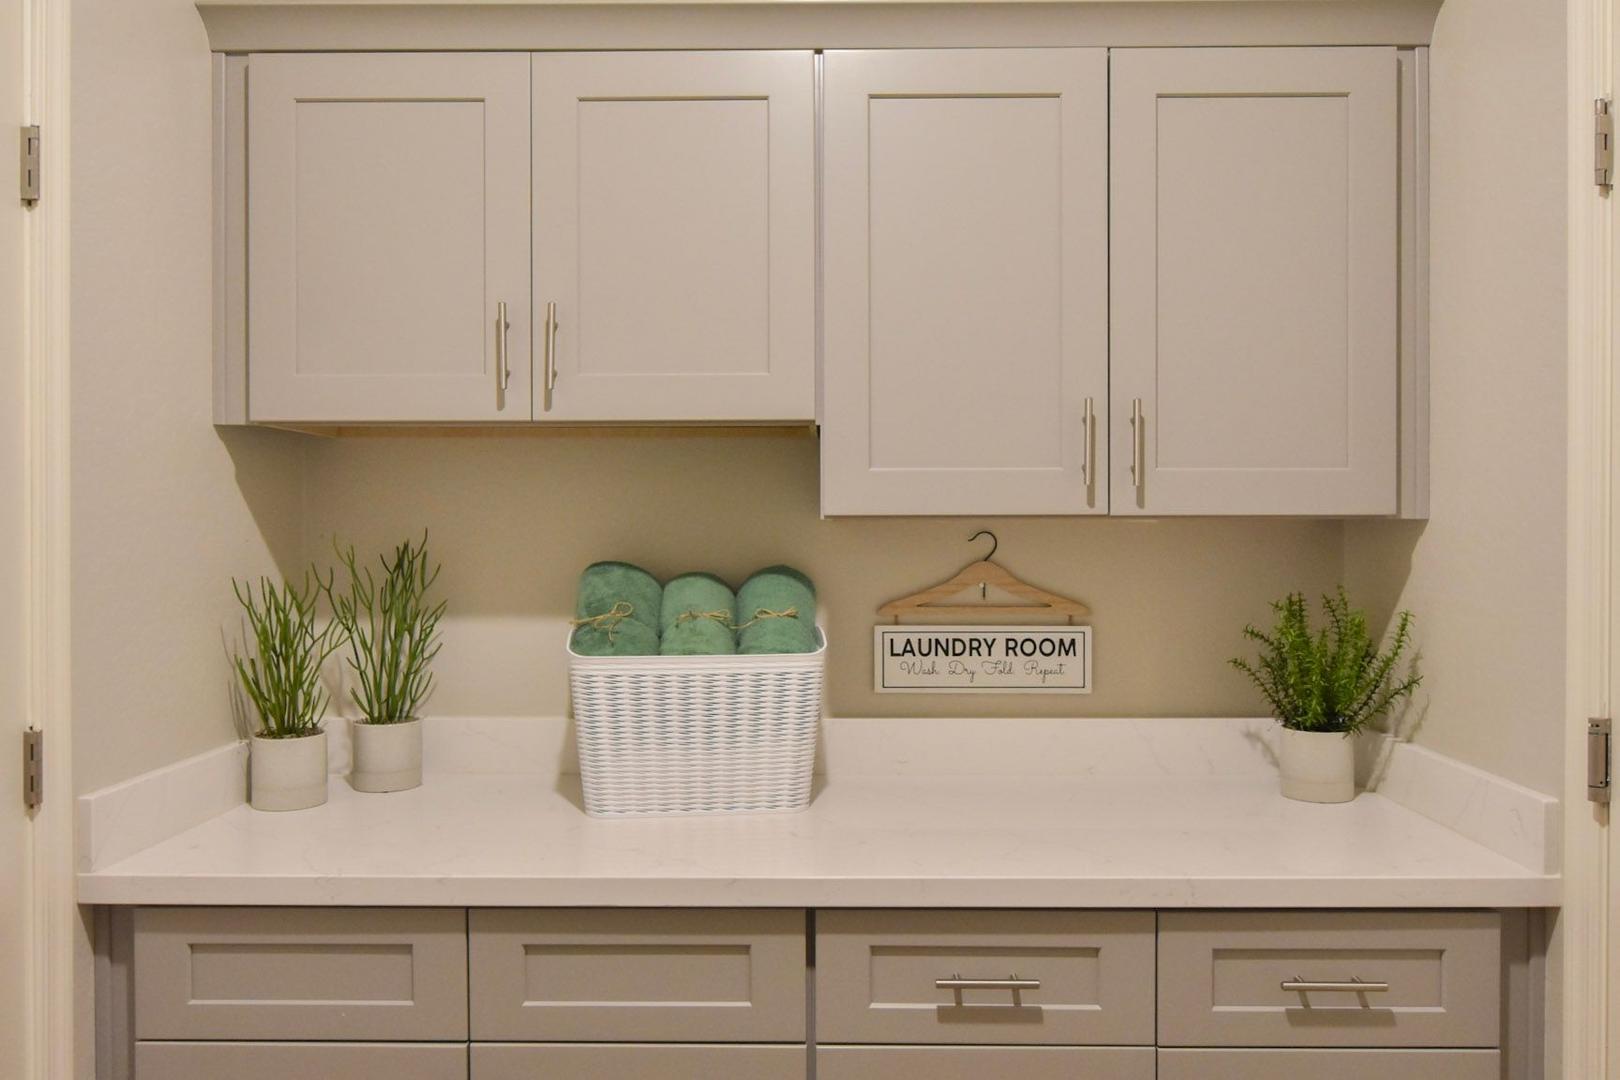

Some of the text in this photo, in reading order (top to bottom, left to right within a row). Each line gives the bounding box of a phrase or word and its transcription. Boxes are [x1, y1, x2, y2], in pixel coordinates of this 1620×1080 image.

[889, 637, 1077, 657] LAUNDRY ROOM
[900, 660, 1066, 683] Wash Dry Fold Repeat
